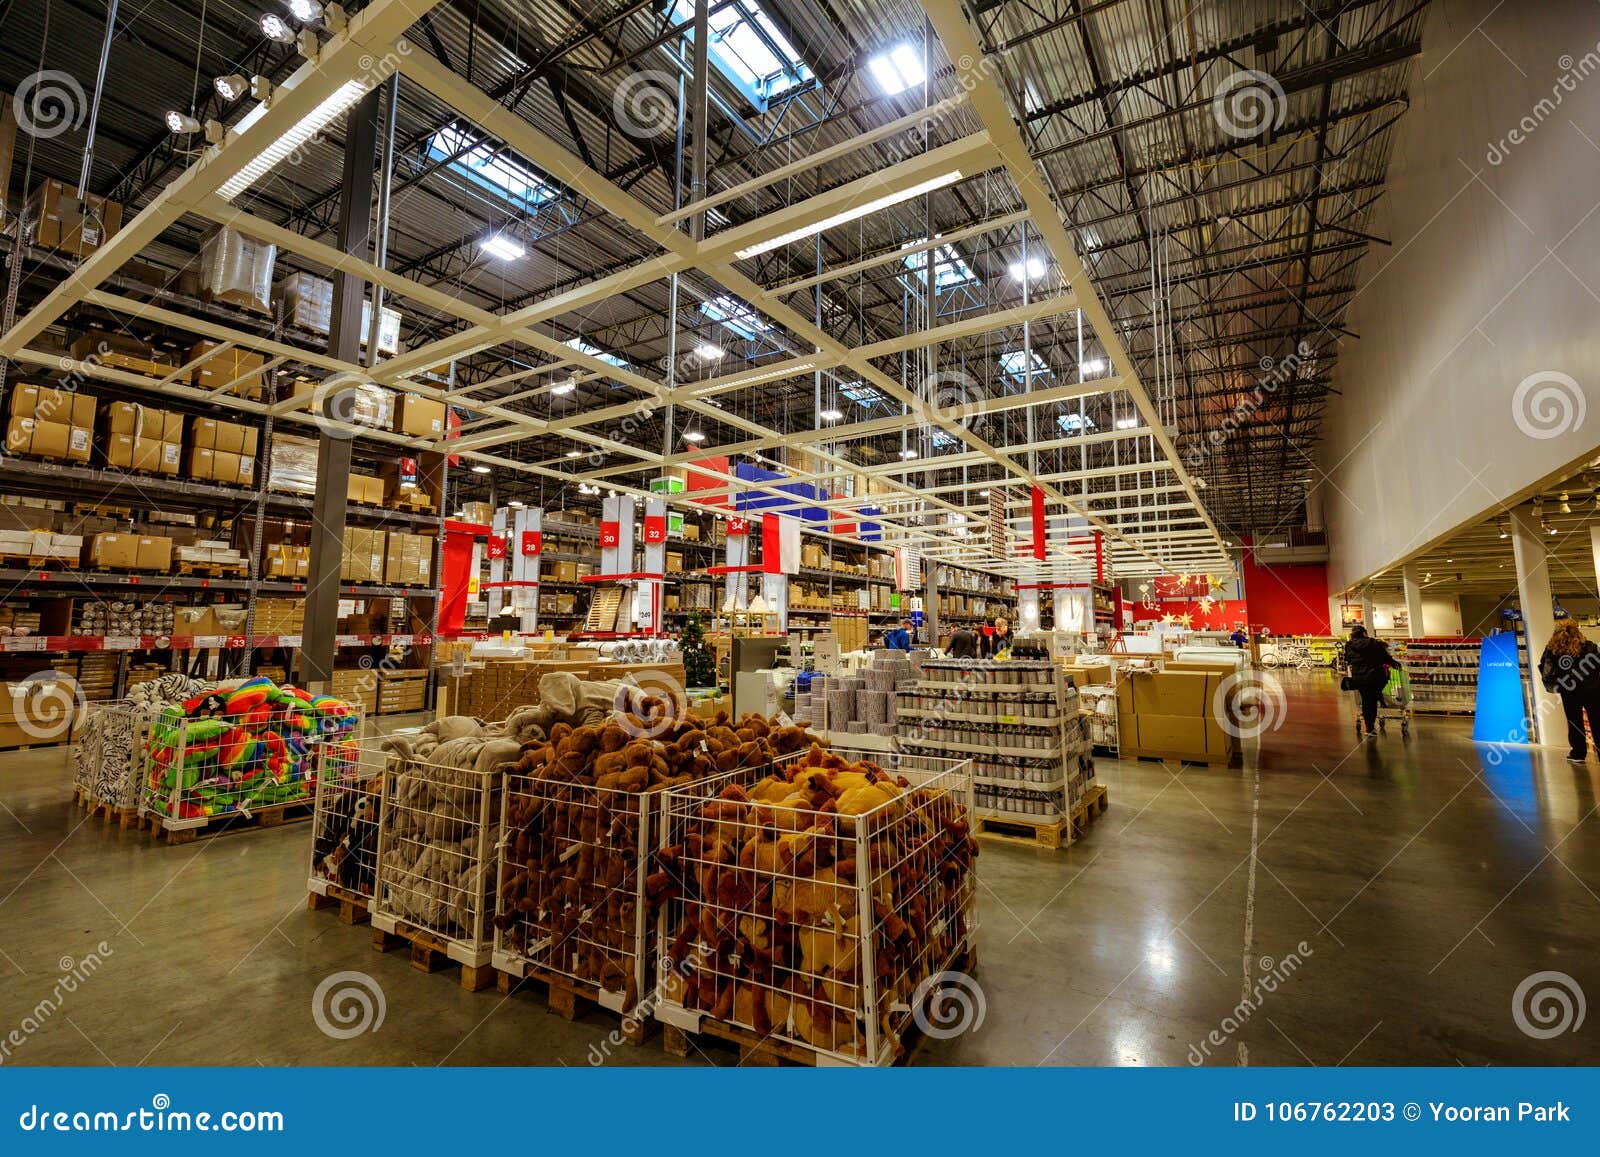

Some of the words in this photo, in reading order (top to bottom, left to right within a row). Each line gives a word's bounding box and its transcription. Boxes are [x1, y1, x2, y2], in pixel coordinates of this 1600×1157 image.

[732, 522, 742, 530] 34
[649, 530, 660, 538] 32
[232, 640, 246, 648] 33
